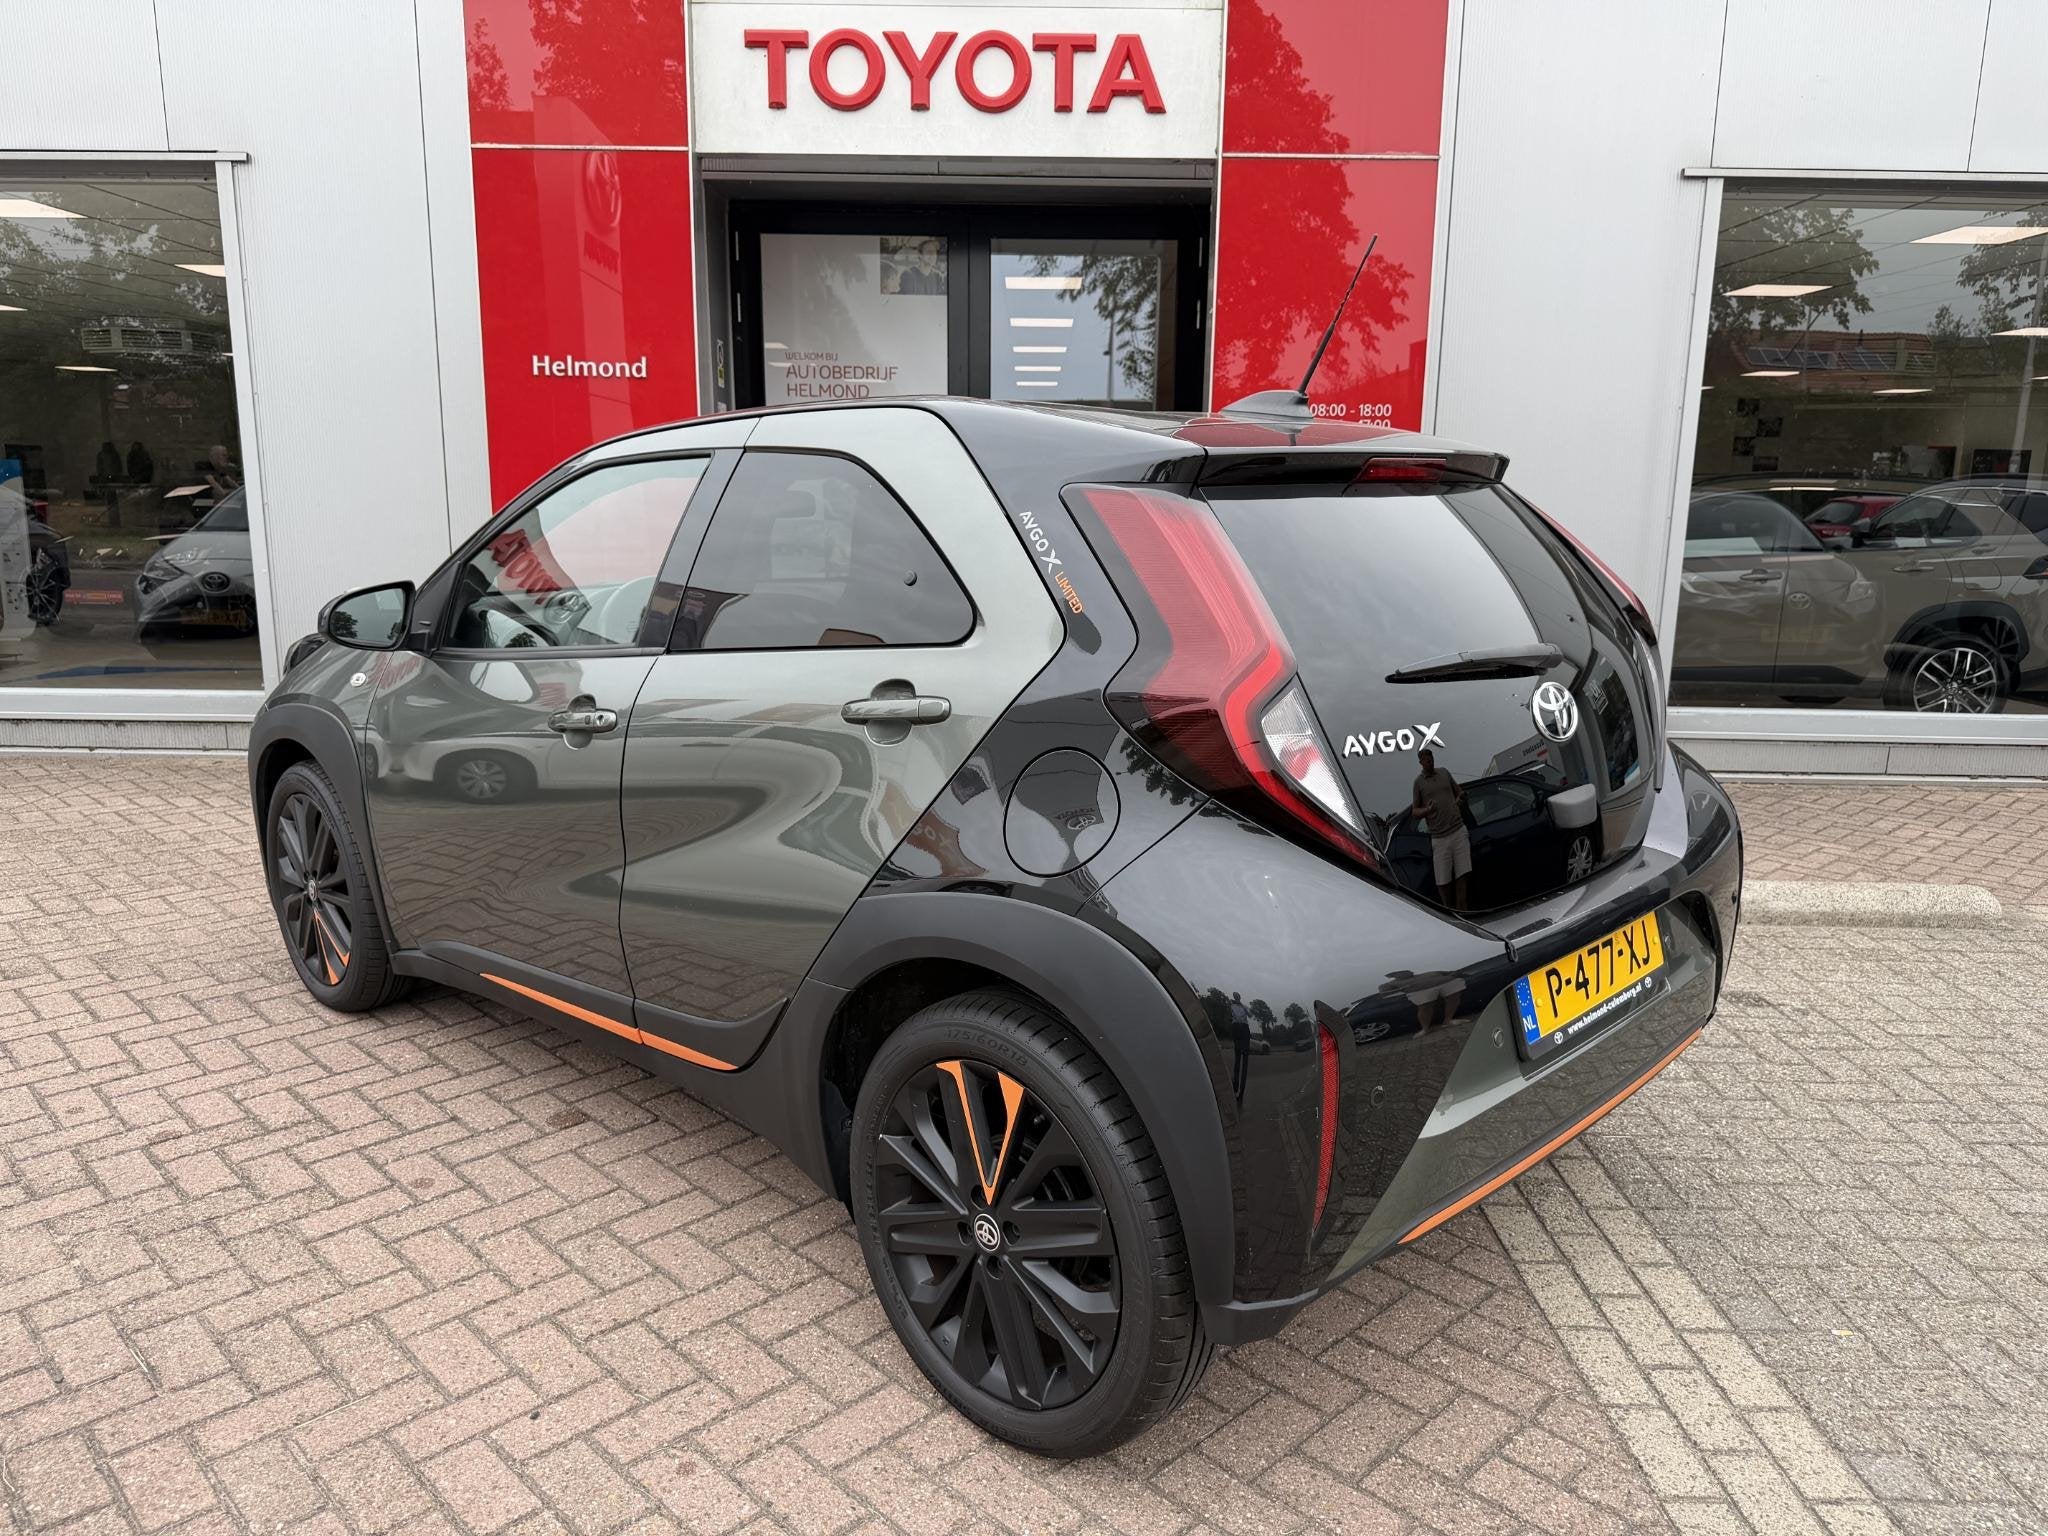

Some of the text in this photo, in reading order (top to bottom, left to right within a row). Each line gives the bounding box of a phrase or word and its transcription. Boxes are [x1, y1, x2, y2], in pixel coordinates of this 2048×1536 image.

[744, 28, 1166, 114] TOYOTA
[785, 352, 838, 361] WELKOM BIJ
[532, 355, 647, 378] Helmond
[786, 365, 898, 381] AUTOBEDRIJF
[787, 383, 870, 399] HELMOND
[1309, 403, 1346, 417] 08:00
[1358, 403, 1392, 417] 18:00
[1055, 571, 1084, 614] LIMITED
[1545, 919, 1651, 1019] P-477-XJ
[1522, 1014, 1537, 1033] NL
